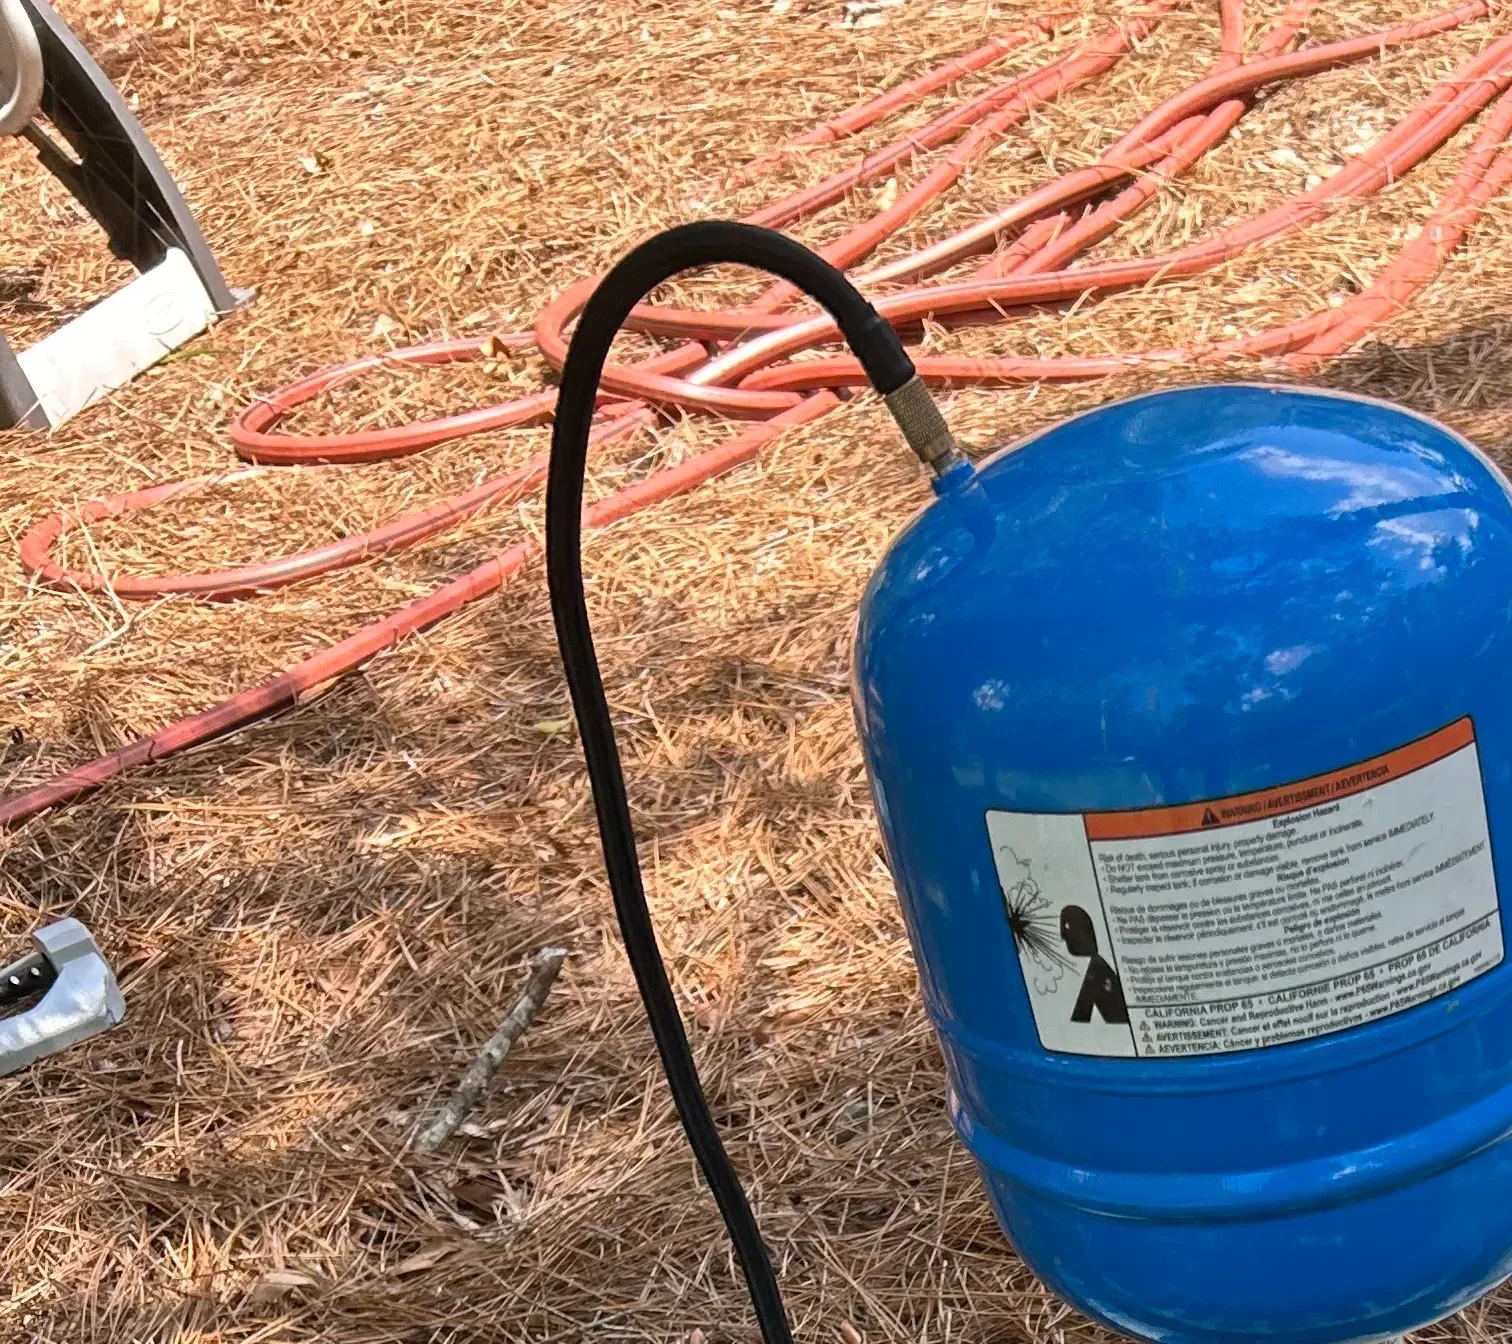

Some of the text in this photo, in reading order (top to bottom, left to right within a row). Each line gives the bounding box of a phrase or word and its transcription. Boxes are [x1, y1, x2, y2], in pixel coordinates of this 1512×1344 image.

[1144, 1005, 1207, 1019] CALIFORNIA
[1209, 1001, 1240, 1013] PROP
[1240, 999, 1254, 1010] 65
[1333, 974, 1362, 990] PROP
[1363, 969, 1375, 981] 65
[1388, 955, 1415, 973] PROP
[1416, 950, 1427, 963] 65
[1428, 943, 1442, 958] DE
[1442, 919, 1491, 951] CALIFORNIA
